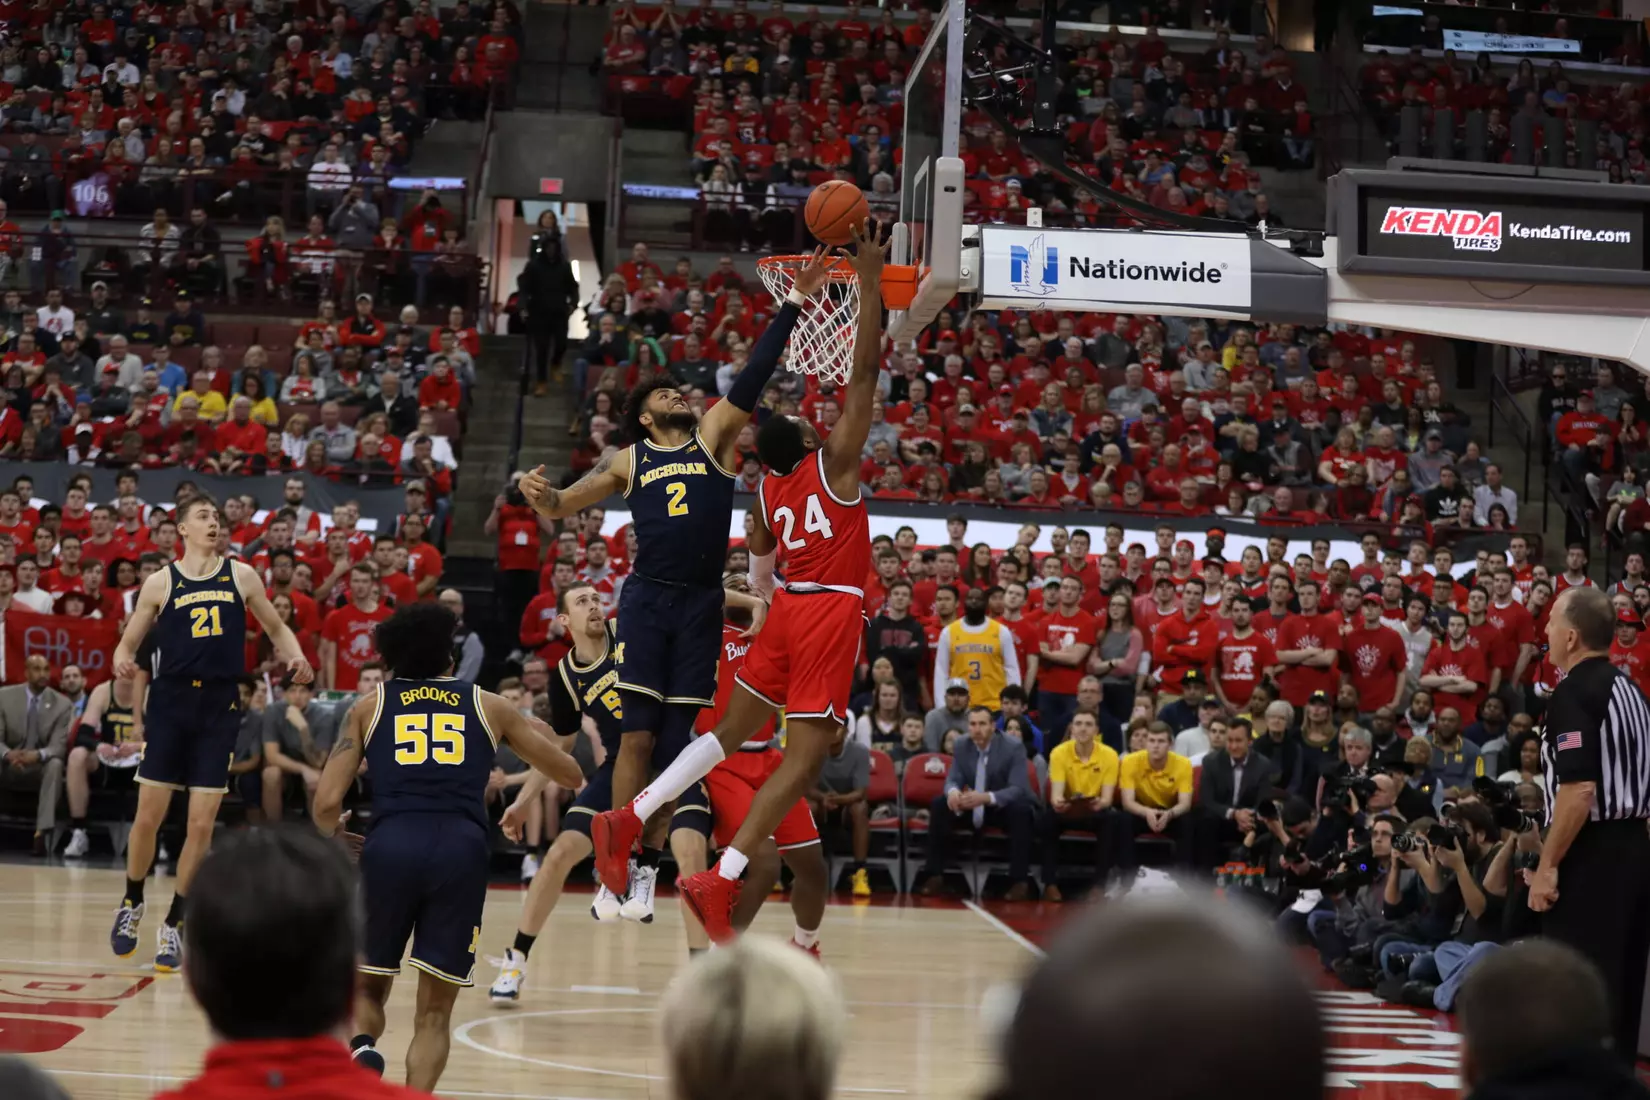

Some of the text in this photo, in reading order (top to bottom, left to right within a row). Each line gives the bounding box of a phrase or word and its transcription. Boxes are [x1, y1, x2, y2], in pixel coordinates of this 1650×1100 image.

[72, 184, 109, 204] 106
[1380, 206, 1632, 244] KENDA KendaTire.com
[1453, 236, 1501, 252] TIRES
[640, 462, 708, 488] MICHIGAN
[665, 481, 690, 517] 2
[773, 493, 834, 550] 24
[174, 590, 235, 609] MICHIGAN
[190, 605, 223, 638] 21
[968, 660, 981, 680] 3
[399, 686, 461, 706] BROOKS
[394, 713, 465, 765] 55
